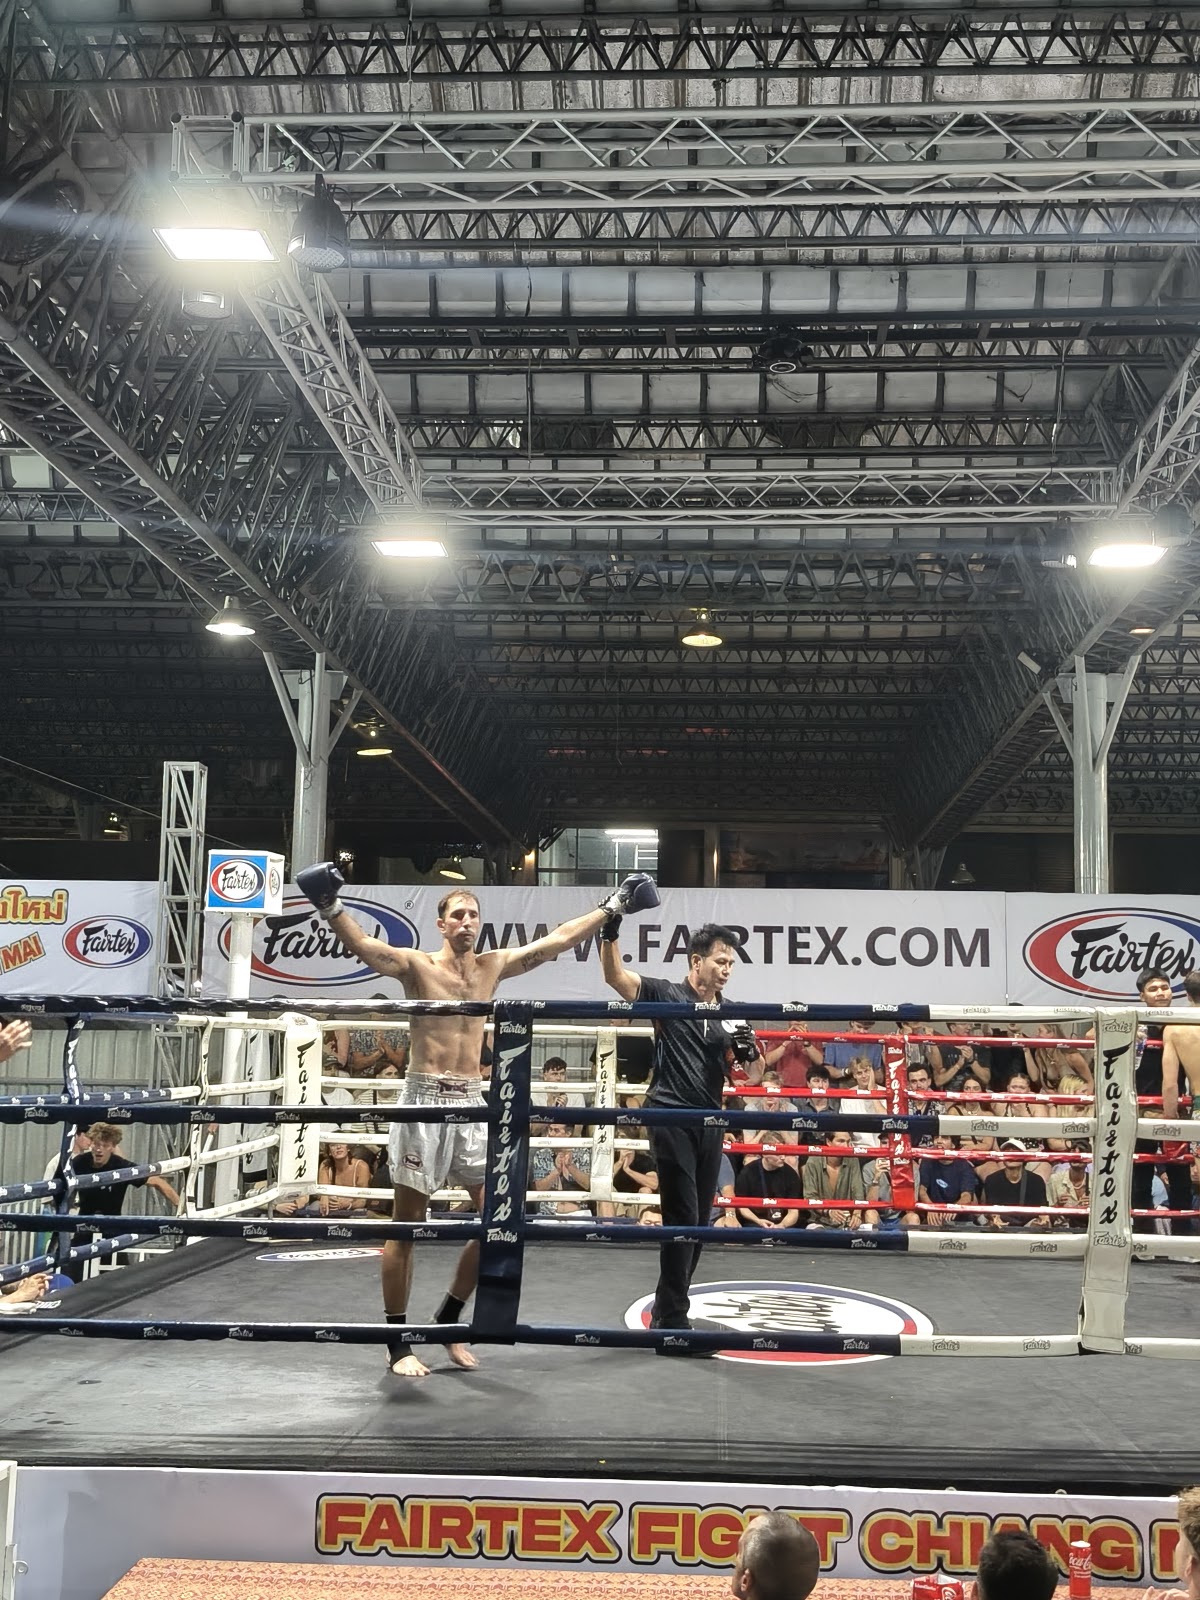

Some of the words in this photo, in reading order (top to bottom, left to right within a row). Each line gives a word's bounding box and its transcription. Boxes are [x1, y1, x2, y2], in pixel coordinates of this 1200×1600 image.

[222, 865, 255, 892] Fairtex
[82, 923, 136, 956] Fairtex
[1, 935, 43, 970] MAI
[1071, 921, 1196, 979] Fairtex
[694, 1001, 721, 1011] Fairtex
[782, 1003, 808, 1013] Fairtex
[872, 1003, 899, 1013] Fairtex
[499, 1021, 527, 1034] Fairtex
[24, 1107, 49, 1118] Fairtex
[107, 1107, 132, 1119] Fairtex
[294, 1038, 317, 1180] Faitex
[190, 1110, 215, 1122] Fairtex
[275, 1111, 300, 1121] Fairtex
[359, 1112, 384, 1122] Fairtex
[444, 1113, 469, 1123] Fairtex
[616, 1114, 642, 1125] Fairtex
[704, 1116, 729, 1126] Fairtex
[792, 1117, 818, 1129] Fairtex
[882, 1118, 909, 1130] Fairtex
[493, 1042, 530, 1222] Fairtex
[1098, 1041, 1133, 1225] Fairtex
[243, 1224, 268, 1236] Fairtex
[328, 1225, 353, 1238] Fairtex
[413, 1228, 438, 1239] Fairtex
[487, 1227, 518, 1243] Fairtex
[1093, 1231, 1127, 1248] Fairtex
[143, 1326, 168, 1339] Fairtex
[228, 1326, 254, 1338] Fairtex
[400, 1331, 426, 1343] Fairtex
[574, 1333, 601, 1344] Fairtex
[663, 1335, 690, 1348] Fairtex
[752, 1337, 779, 1349] Fairtex
[843, 1338, 870, 1351] Fairtex
[932, 1339, 960, 1351] Fairtex
[1022, 1338, 1051, 1352] Fairtex
[320, 1500, 616, 1556] FAIRTEX
[634, 1508, 846, 1564] FIGT
[864, 1514, 1138, 1575] CHING
